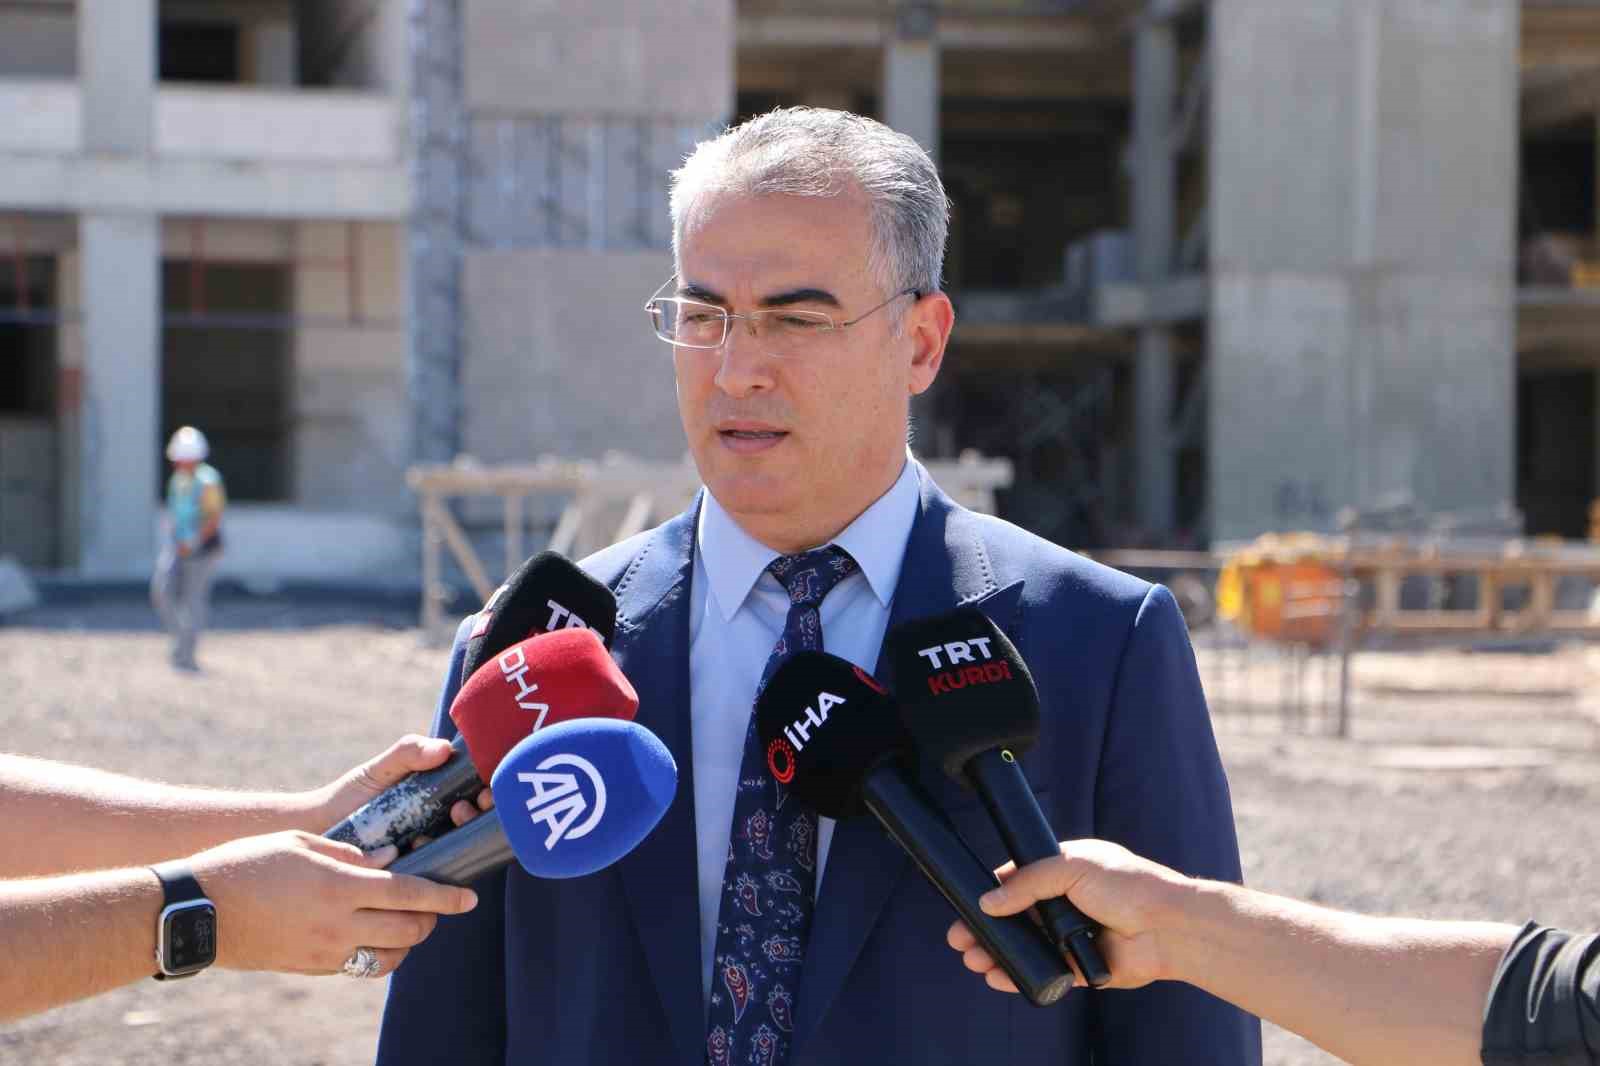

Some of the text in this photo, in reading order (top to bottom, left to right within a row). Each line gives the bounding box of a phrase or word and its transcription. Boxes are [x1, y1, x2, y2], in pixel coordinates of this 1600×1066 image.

[546, 600, 606, 642] TR
[918, 637, 992, 669] TRT
[517, 772, 588, 851] AA
